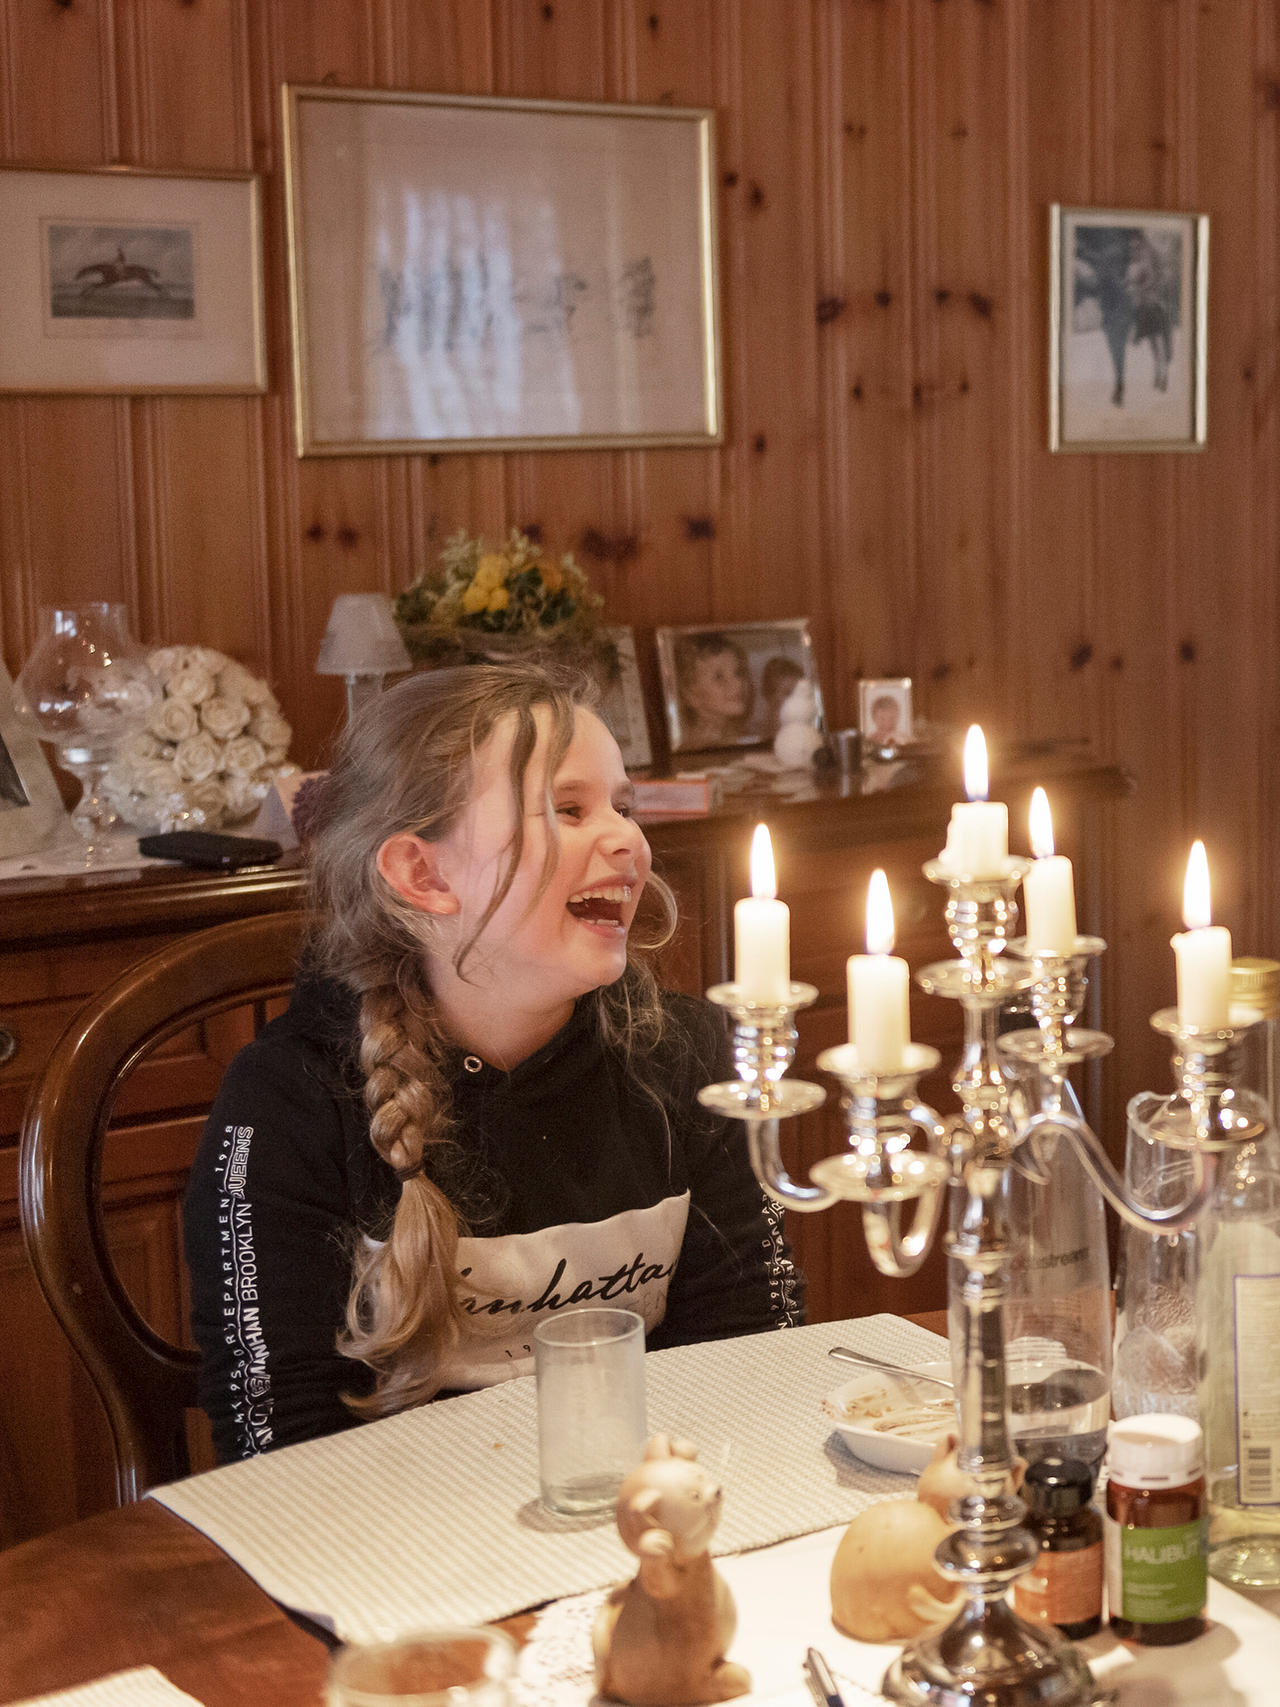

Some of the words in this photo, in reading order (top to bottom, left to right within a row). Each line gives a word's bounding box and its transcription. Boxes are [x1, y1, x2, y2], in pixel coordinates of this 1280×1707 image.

[214, 1125, 233, 1172] 1998
[228, 1126, 254, 1199] QUEENS
[236, 1203, 258, 1301] BROOKLYN
